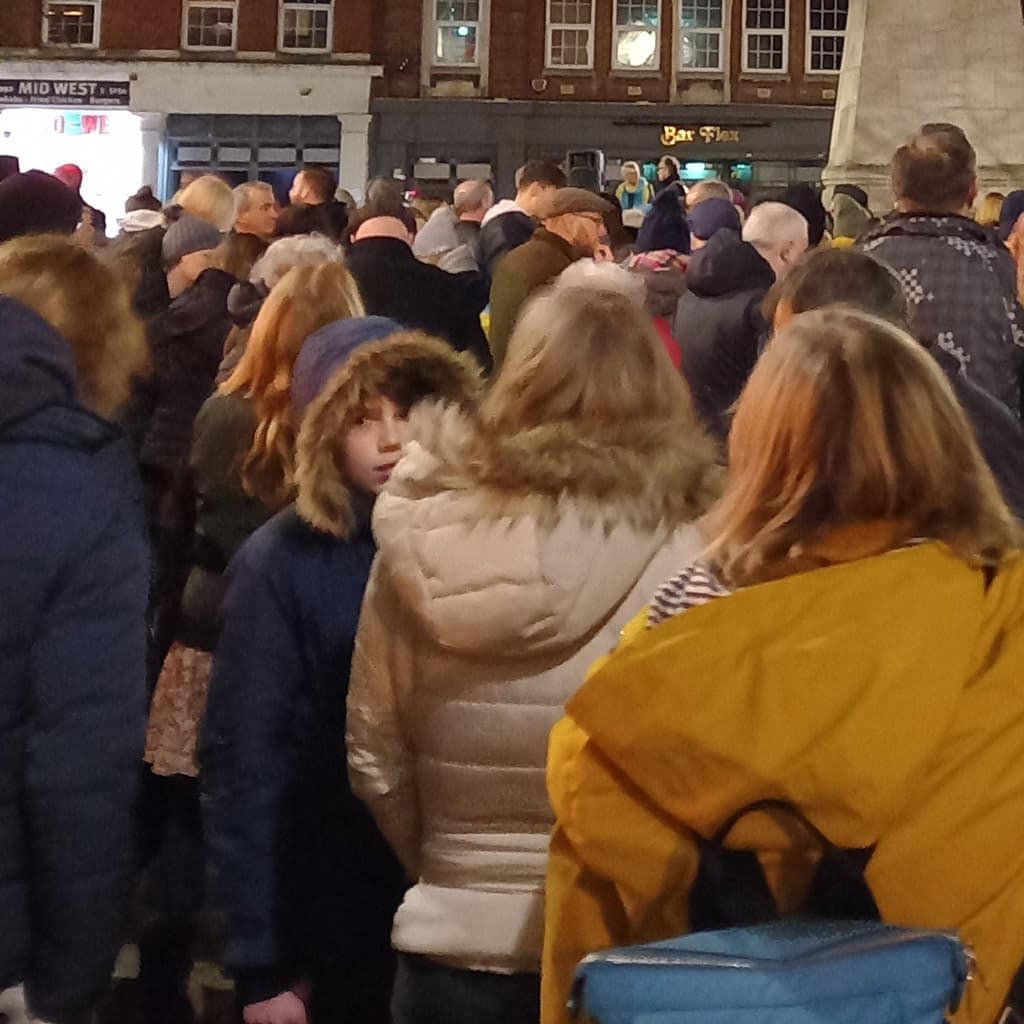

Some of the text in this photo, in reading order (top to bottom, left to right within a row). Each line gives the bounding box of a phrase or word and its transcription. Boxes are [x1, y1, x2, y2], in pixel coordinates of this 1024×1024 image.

[18, 81, 50, 95] MID
[53, 82, 98, 96] WEST
[660, 125, 696, 146] Bar
